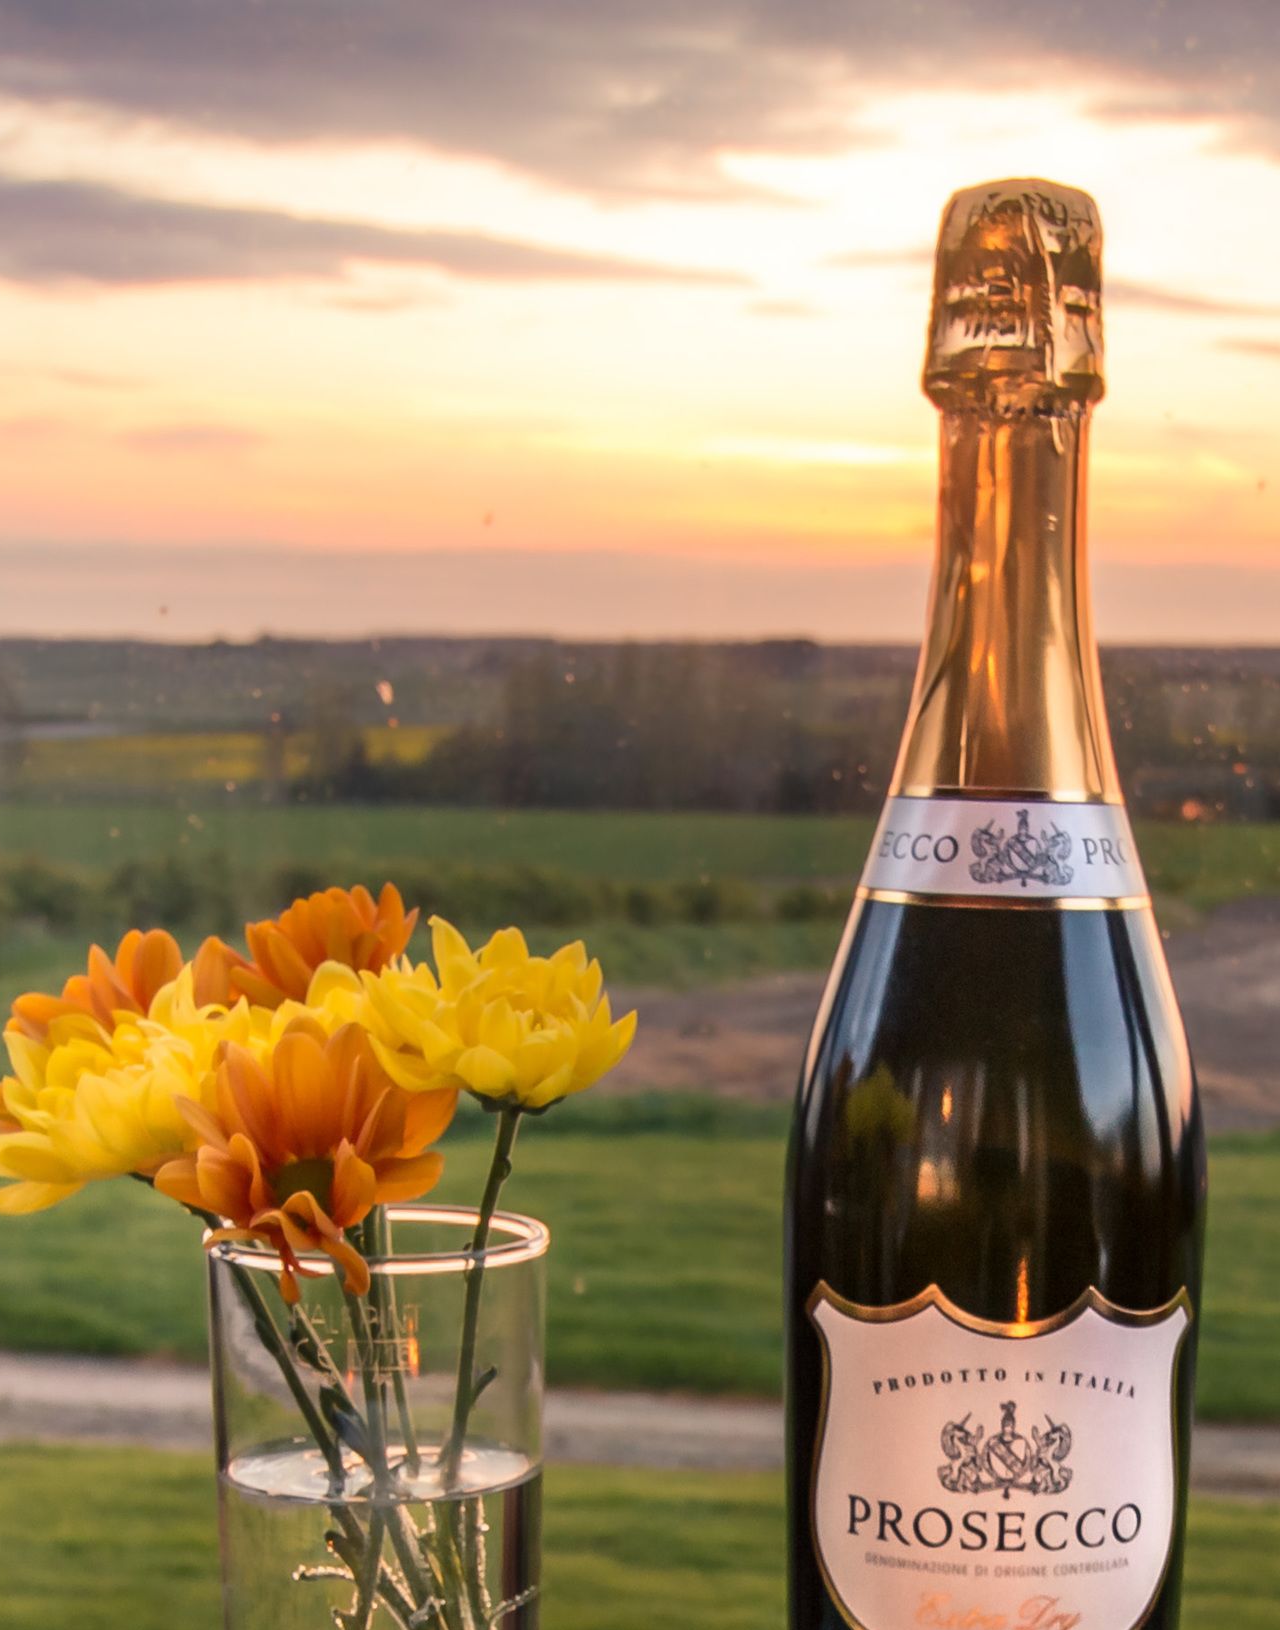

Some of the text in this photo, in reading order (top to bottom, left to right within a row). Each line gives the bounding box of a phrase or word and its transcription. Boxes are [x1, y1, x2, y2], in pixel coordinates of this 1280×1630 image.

[873, 1368, 1007, 1395] PRODOTTO
[1060, 1371, 1135, 1398] ITALIA
[847, 1494, 1142, 1552] PROSECCO
[865, 1551, 968, 1577] DENOMINAZIONE
[974, 1564, 989, 1576] DI
[994, 1564, 1048, 1578] ORIGINE
